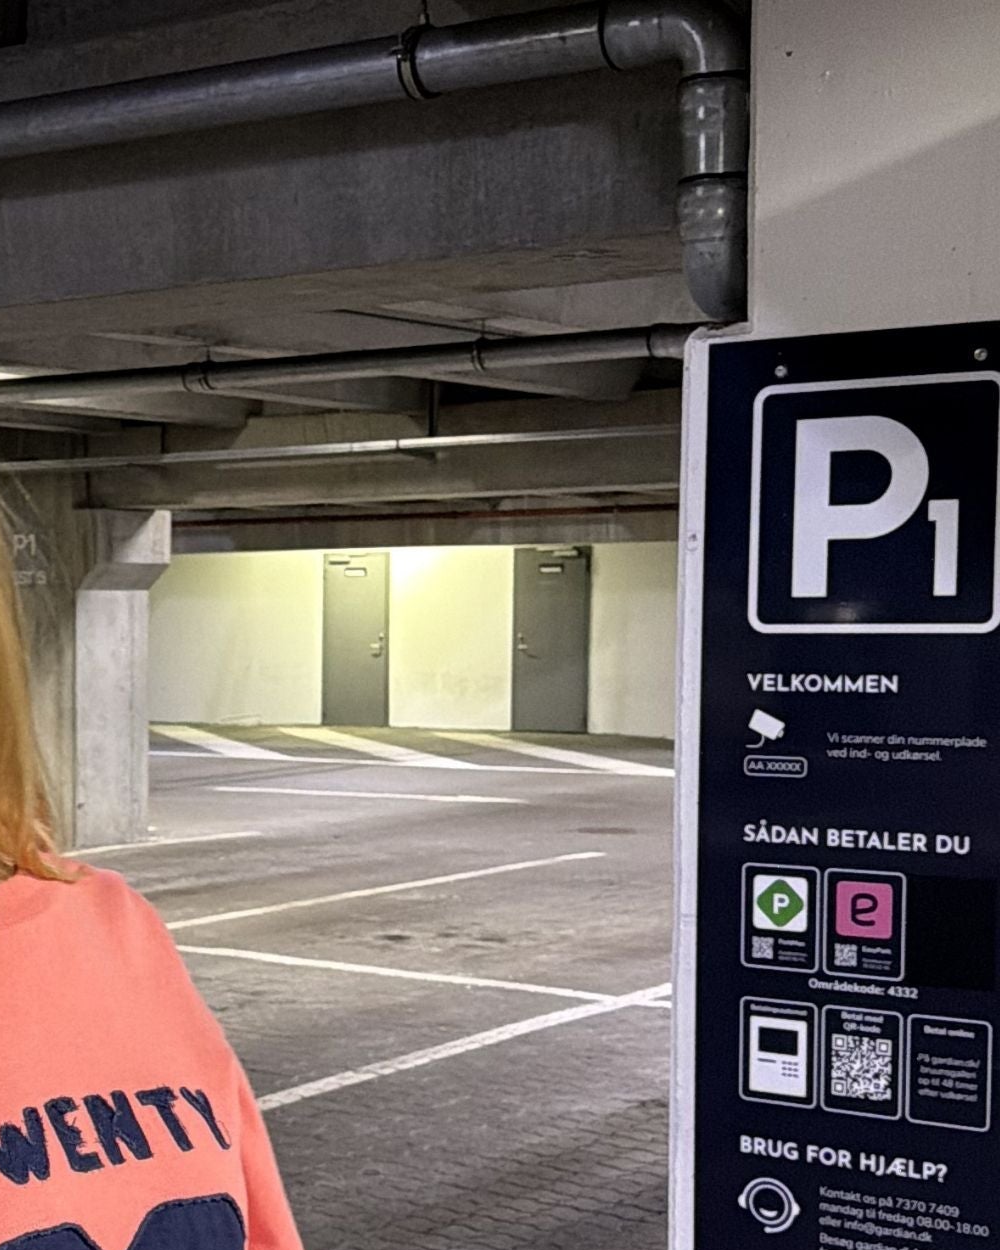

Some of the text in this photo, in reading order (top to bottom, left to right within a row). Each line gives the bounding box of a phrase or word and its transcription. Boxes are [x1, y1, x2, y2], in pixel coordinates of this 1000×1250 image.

[747, 673, 899, 694] VELKOMMEN
[826, 732, 988, 749] Vi scanner din nummerplade
[748, 760, 765, 770] AA
[826, 748, 847, 758] ved
[874, 750, 890, 762] og
[743, 819, 970, 855] SÅDAN BETALER DU
[772, 893, 790, 915] P
[850, 893, 879, 926] e
[808, 978, 918, 999] Områdekode: 4332
[739, 1134, 948, 1183] BRUG FOR HJÆLP?
[819, 1186, 960, 1218] Kontakt os på 7370 7409
[819, 1202, 864, 1219] mandag
[865, 1208, 876, 1218] til
[878, 1209, 915, 1227] fredag
[818, 1215, 933, 1242] eller info@gardian.dk
[819, 1232, 854, 1250] Besøg
